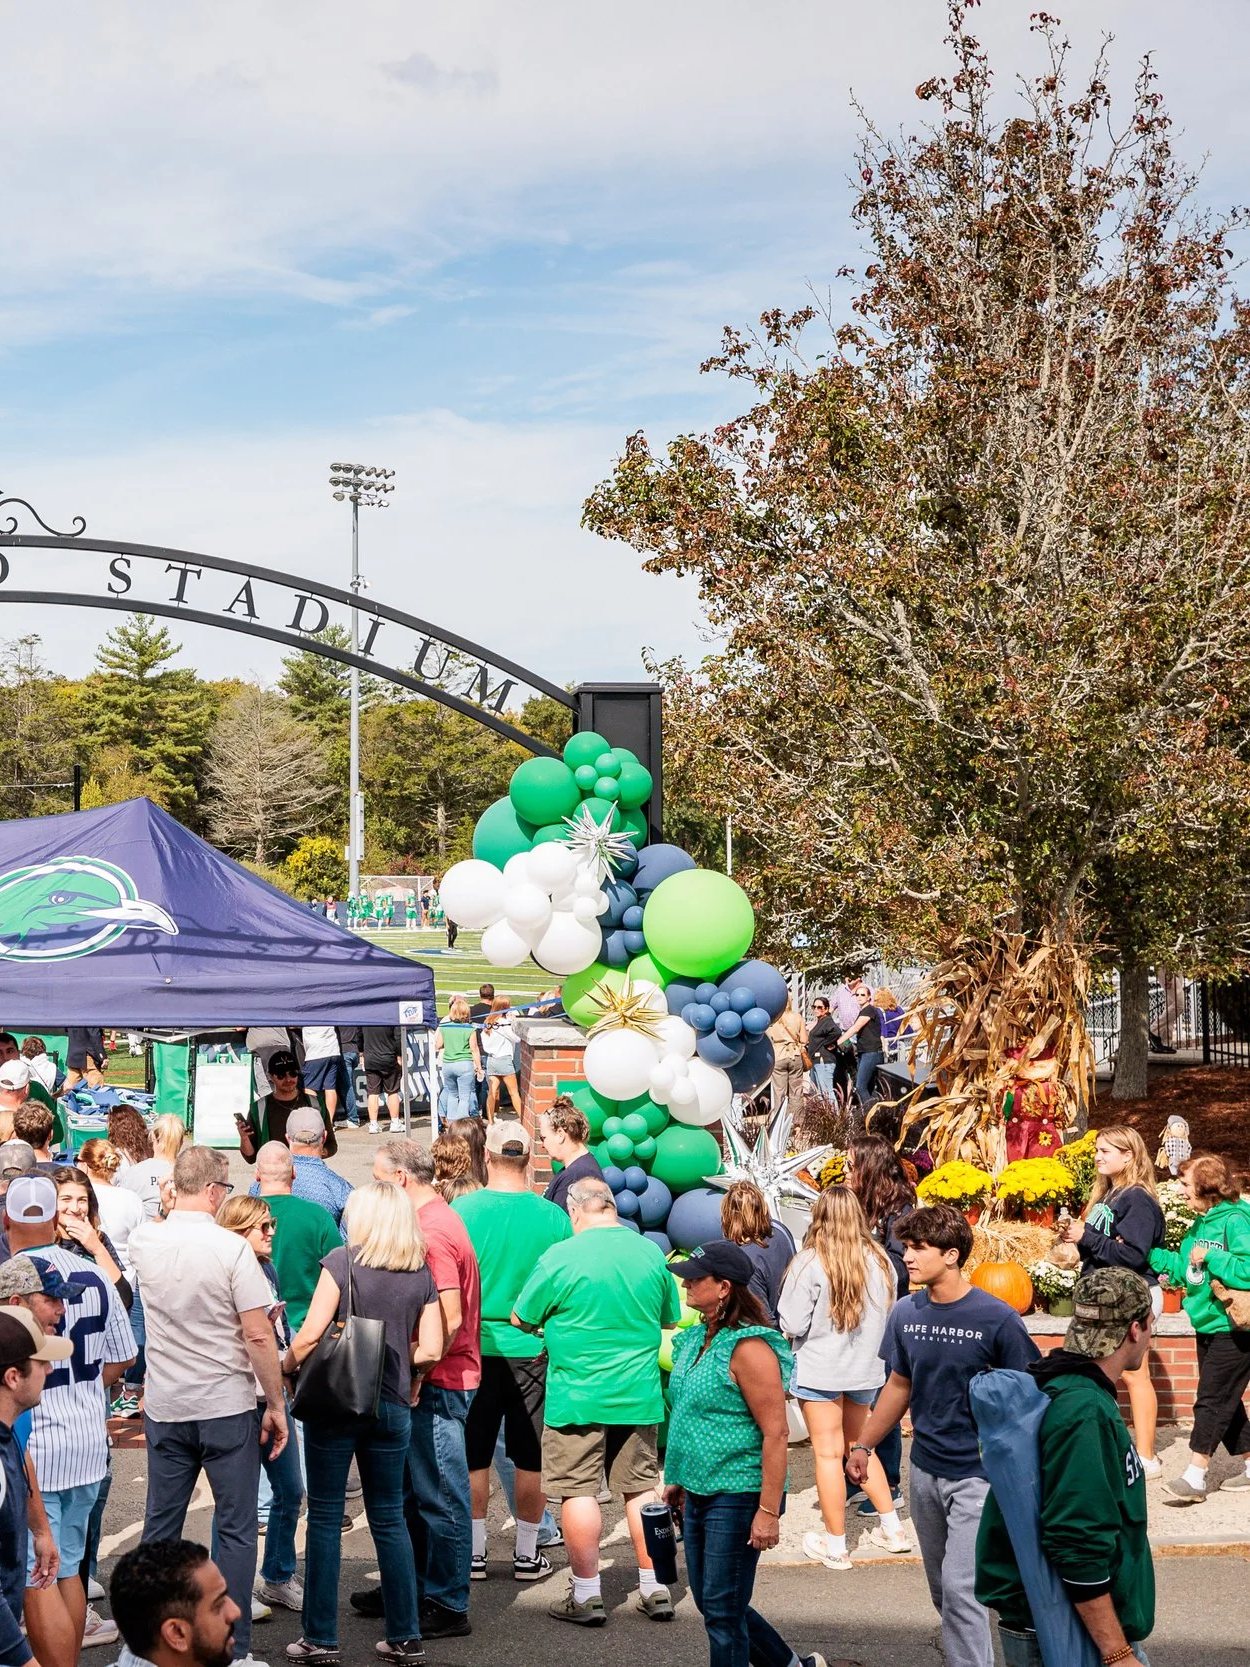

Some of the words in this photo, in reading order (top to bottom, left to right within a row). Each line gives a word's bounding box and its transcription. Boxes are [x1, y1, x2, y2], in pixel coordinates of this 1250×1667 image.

[107, 556, 520, 715] STADIUM
[903, 1324, 928, 1333] SAFE
[932, 1325, 983, 1340] HARBOR
[914, 1335, 963, 1345] MARINAS
